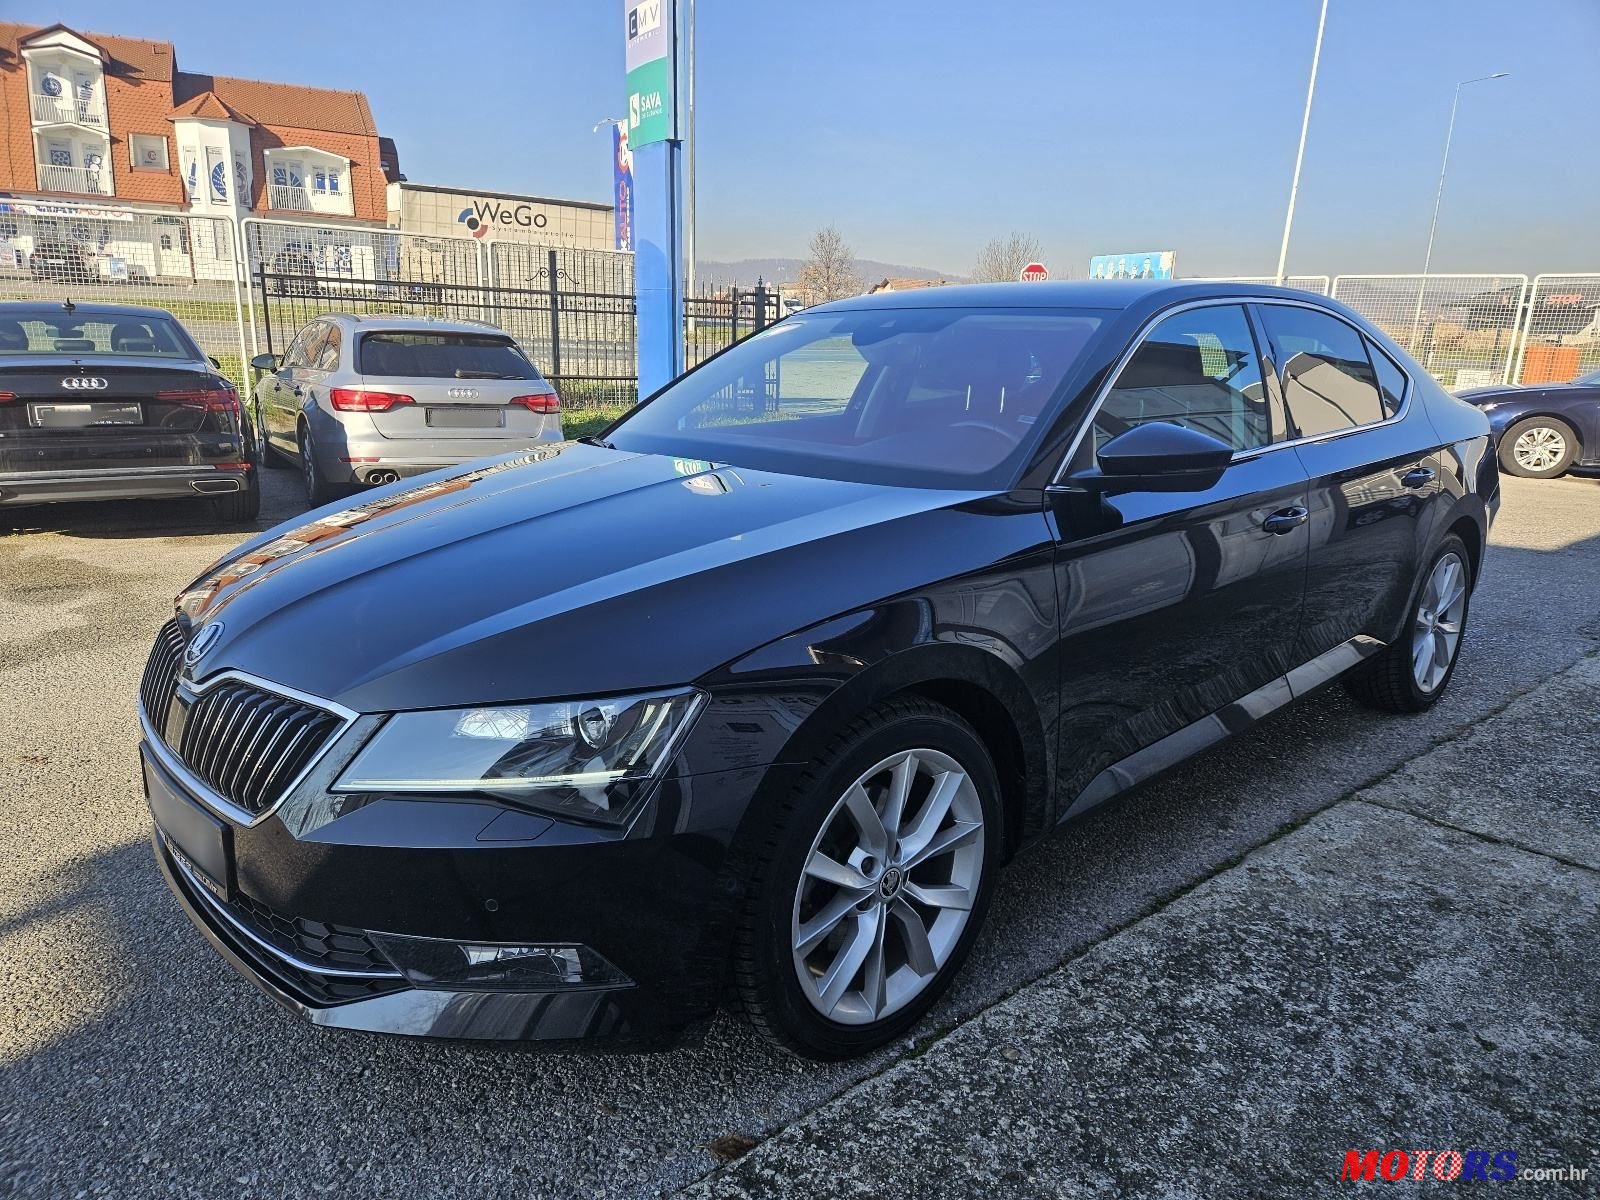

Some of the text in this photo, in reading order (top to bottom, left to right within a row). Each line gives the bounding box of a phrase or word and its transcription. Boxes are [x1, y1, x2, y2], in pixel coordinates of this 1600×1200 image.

[629, 3, 658, 40] CMV
[641, 91, 661, 111] SAVA
[474, 200, 547, 228] WeGo
[1022, 271, 1047, 282] STOP
